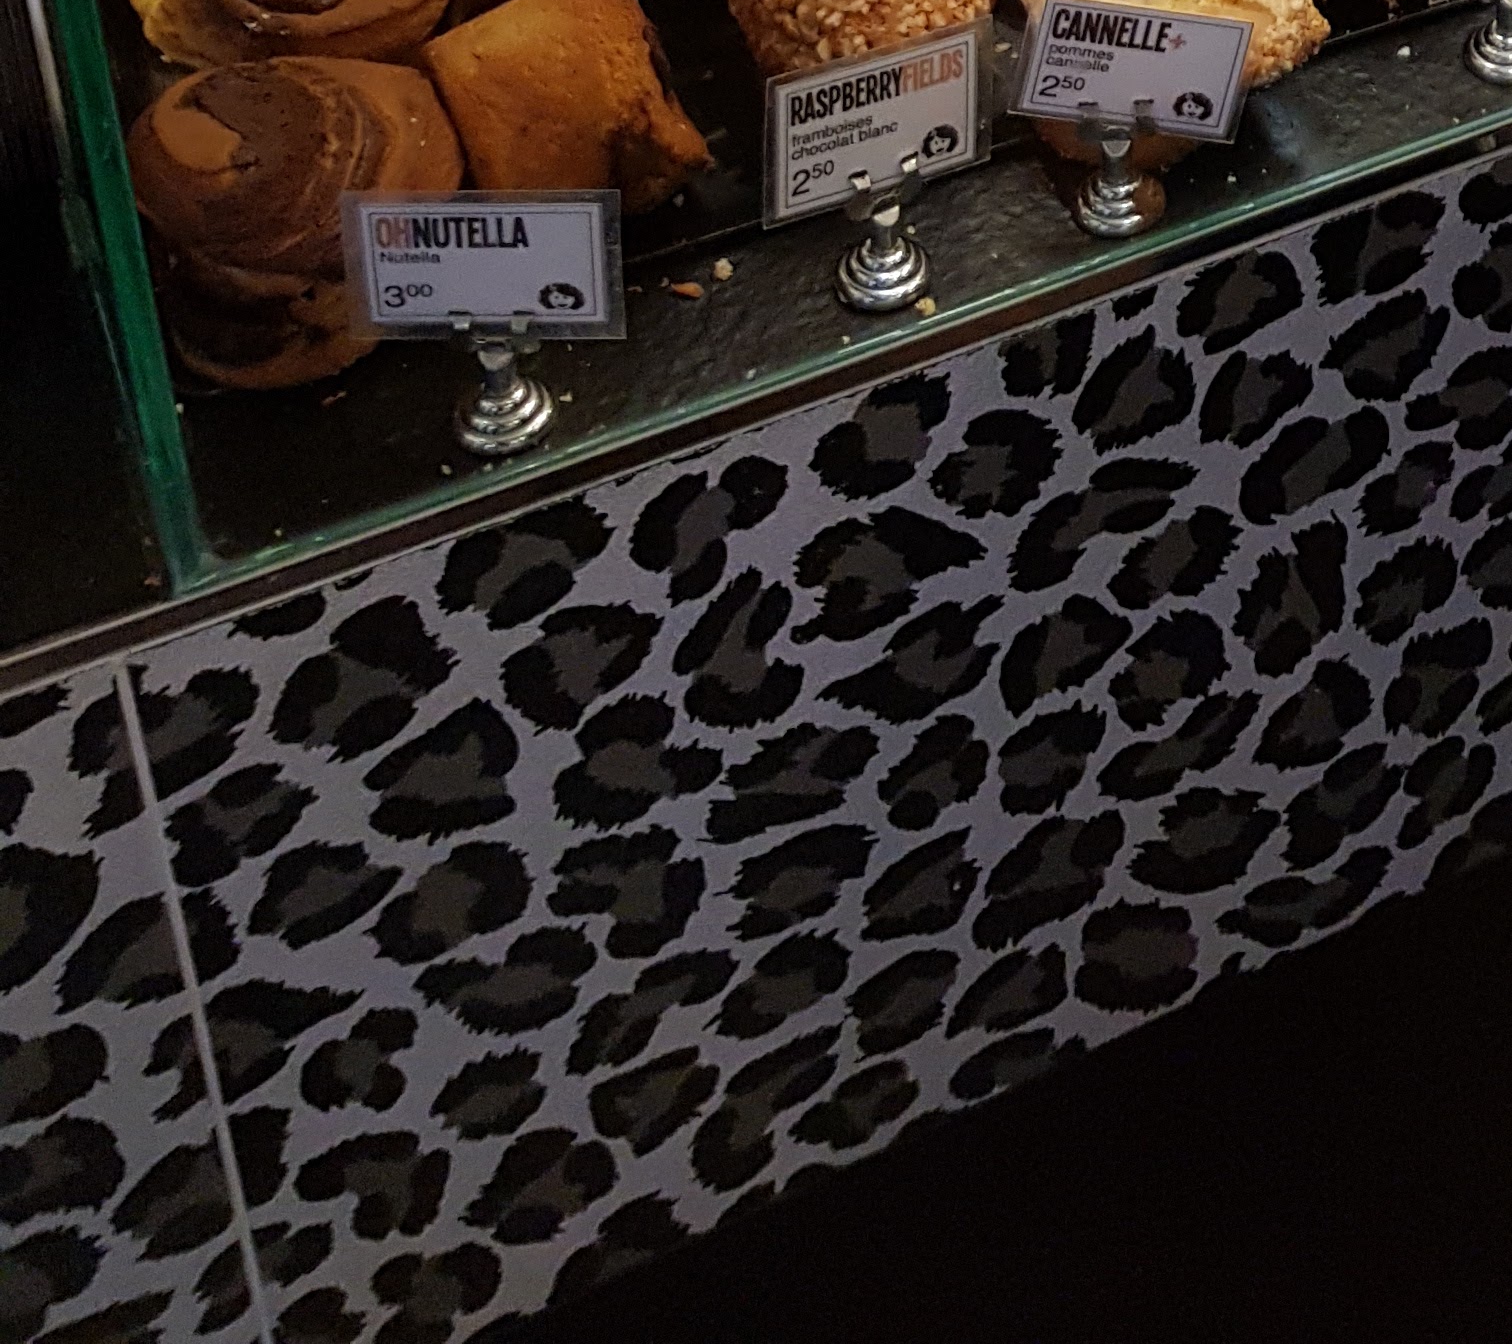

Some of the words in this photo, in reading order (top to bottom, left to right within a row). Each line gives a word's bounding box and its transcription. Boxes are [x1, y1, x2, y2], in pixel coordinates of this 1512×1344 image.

[1048, 43, 1115, 62] pommes
[790, 48, 964, 126] RASPBERRYFIELDS
[791, 115, 873, 148] framboises
[791, 130, 855, 161] chocolat
[858, 121, 899, 143] blanc
[375, 216, 529, 249] OHNUTELLA
[379, 251, 441, 264] Nutella
